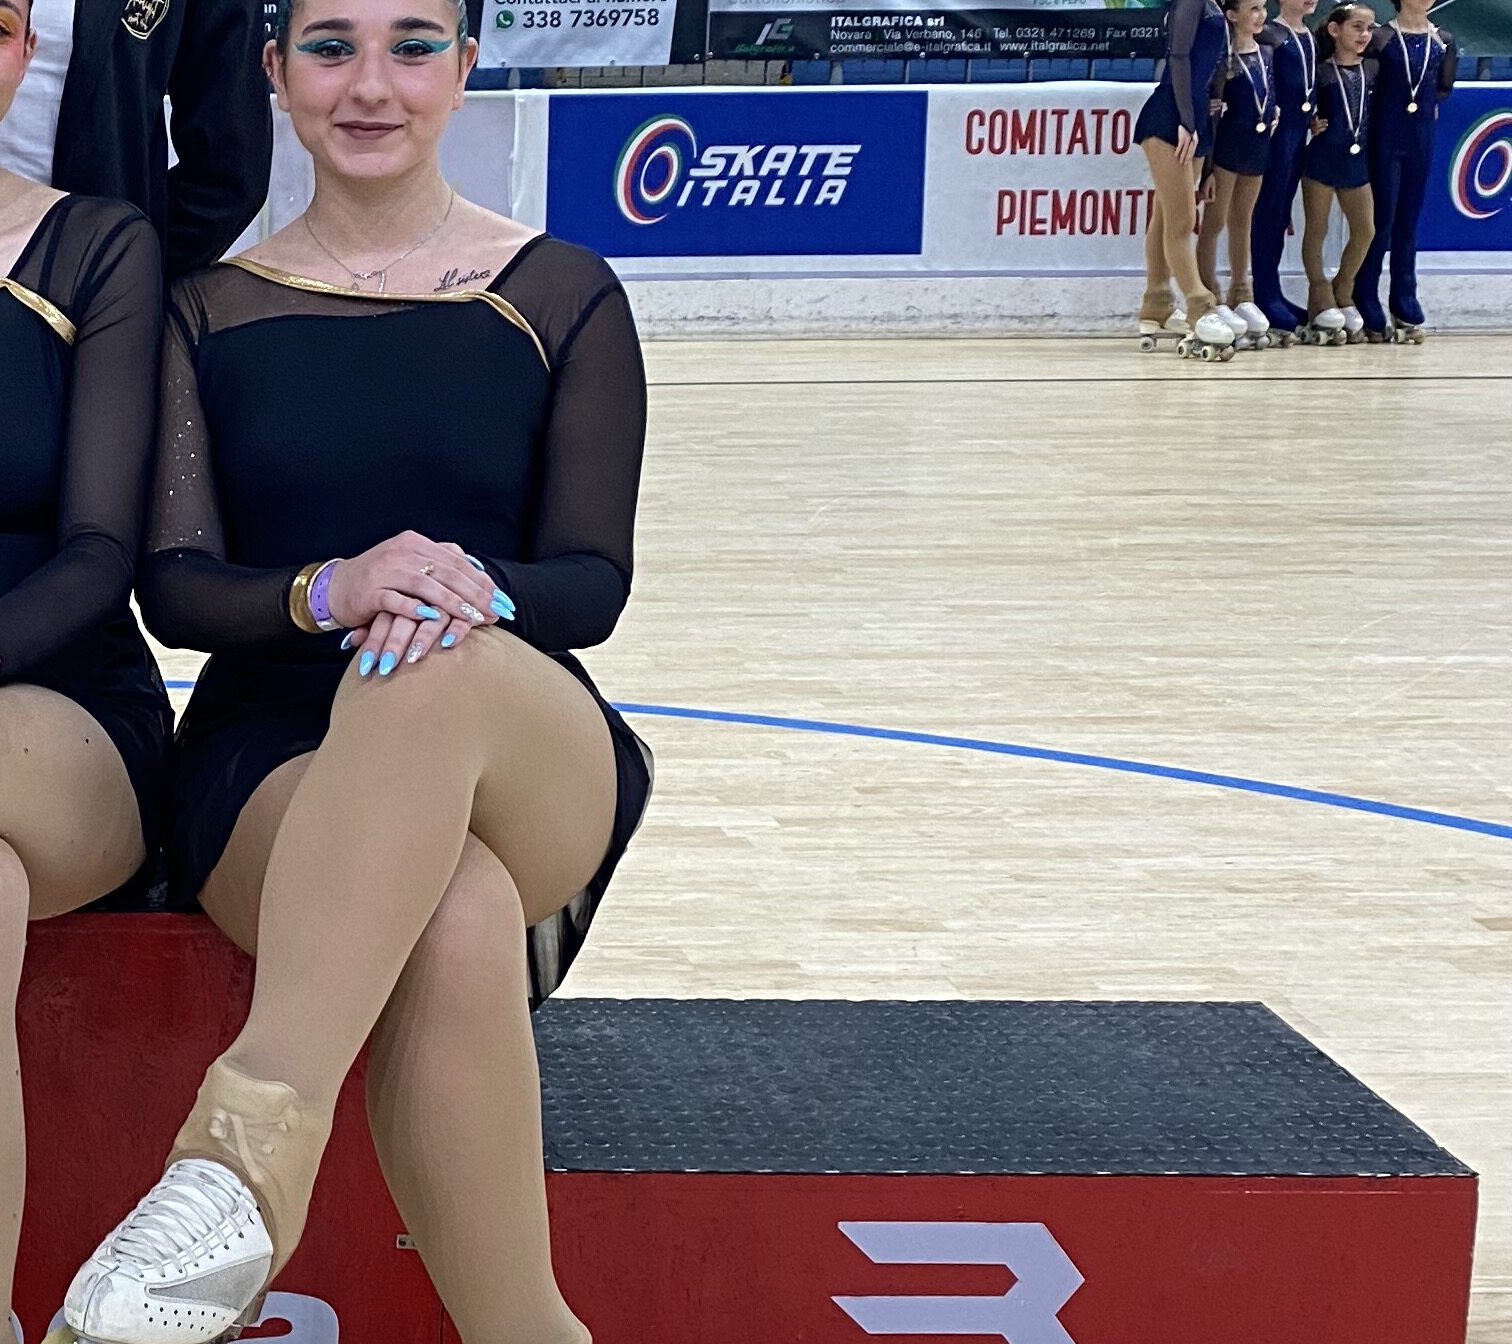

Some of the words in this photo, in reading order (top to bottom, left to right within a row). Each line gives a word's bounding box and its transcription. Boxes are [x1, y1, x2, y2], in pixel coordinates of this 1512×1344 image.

[521, 9, 562, 29] 338
[569, 8, 661, 29] 7369758
[830, 15, 924, 27] ITALGRAFICA
[926, 15, 945, 27] srl
[830, 28, 872, 40] Novara
[882, 27, 902, 40] Via
[992, 26, 1013, 39] Tel.
[1015, 26, 1045, 39] 0321
[1105, 26, 1127, 39] Fax
[1129, 26, 1160, 39] 0321
[964, 108, 1132, 155] COMITATO
[688, 143, 862, 177] SKATE
[676, 177, 848, 207] ITALIA
